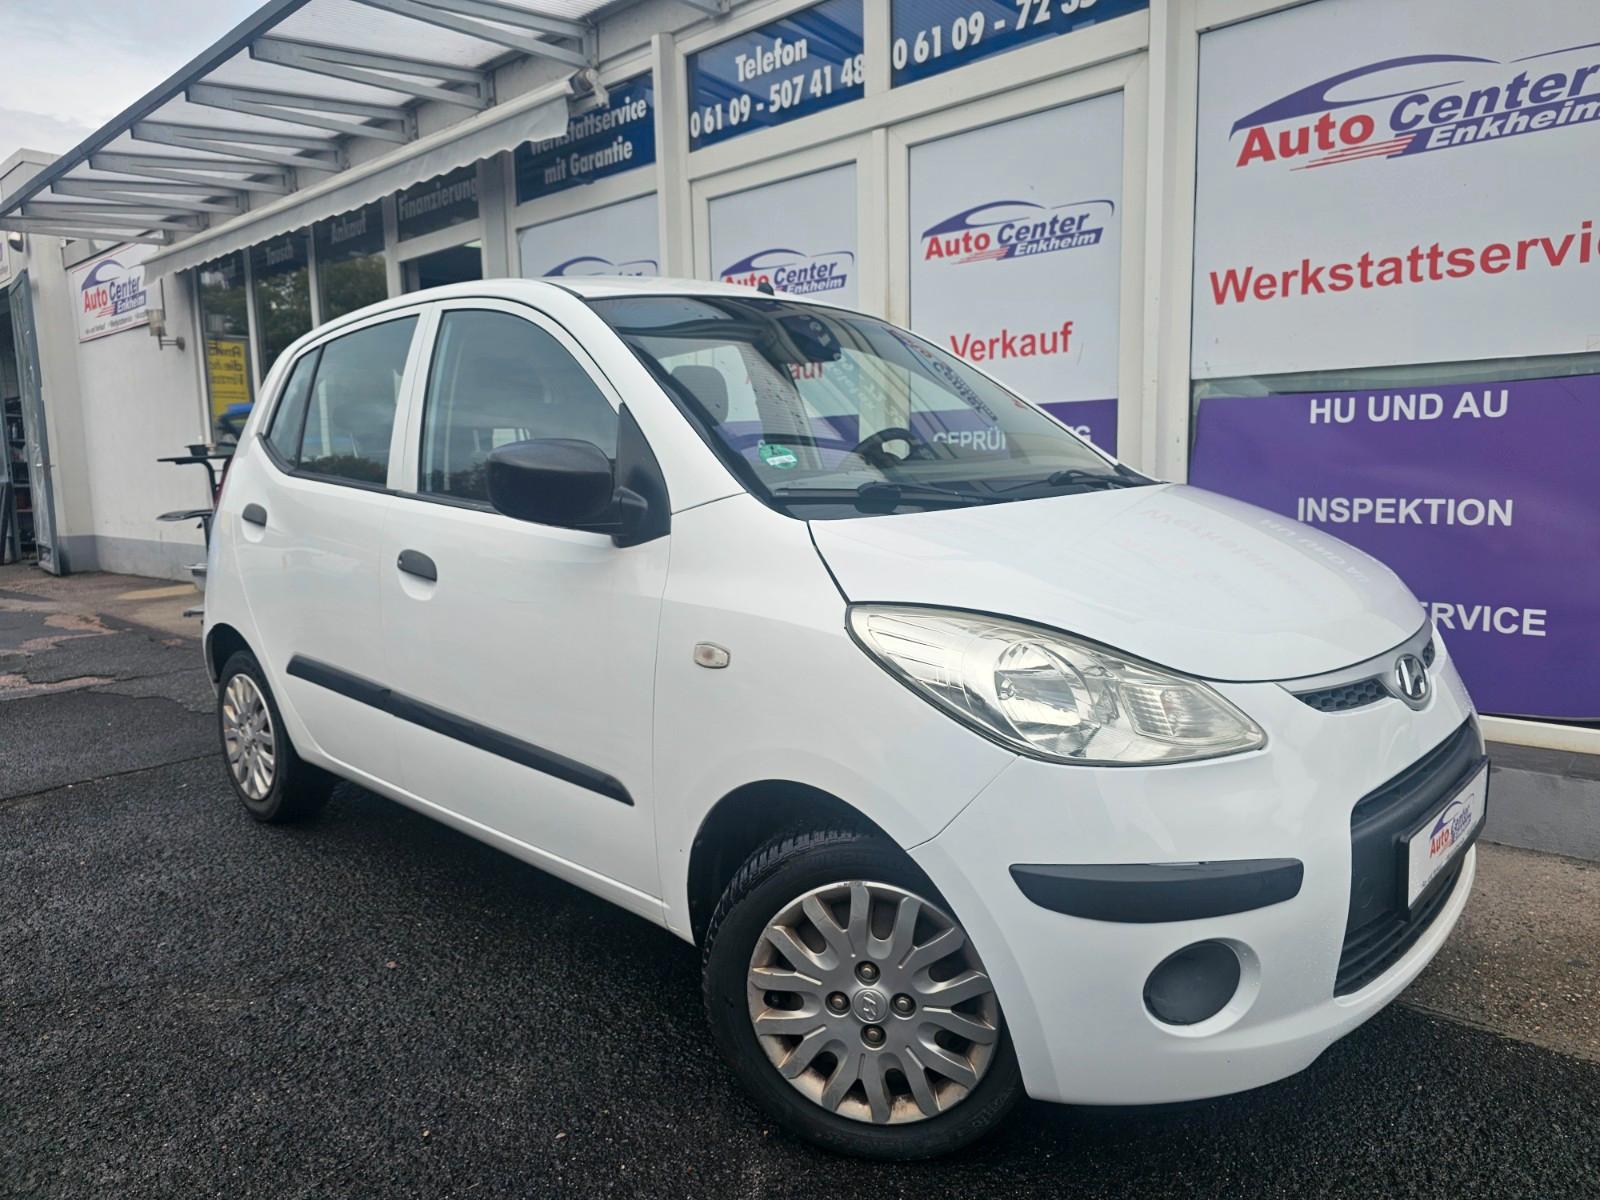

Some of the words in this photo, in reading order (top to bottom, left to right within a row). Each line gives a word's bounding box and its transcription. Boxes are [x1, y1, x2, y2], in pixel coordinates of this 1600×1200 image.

[735, 37, 807, 82] Telefon
[893, 38, 908, 70] 0
[914, 25, 941, 63] 61
[952, 11, 984, 50] 09
[690, 111, 700, 138] 0
[704, 104, 722, 134] 61
[729, 94, 750, 125] 09
[769, 75, 804, 113] 507
[810, 65, 832, 97] 41
[840, 53, 865, 87] 48
[1236, 112, 1374, 168] Auto
[1389, 64, 1600, 132] Center
[1425, 100, 1600, 150] Enkheim
[544, 157, 567, 185] mit
[570, 135, 633, 176] Garantie
[399, 178, 479, 221] Finanzierung
[925, 230, 990, 261] Auto
[997, 213, 1090, 245] Center
[1014, 231, 1096, 257] Enkheim
[774, 261, 838, 285] Center
[1209, 220, 1600, 305] Werkstattservi
[84, 287, 108, 312] Auto
[109, 276, 141, 301] Center
[786, 279, 842, 294] Enkheim
[950, 321, 1073, 362] Verkauf
[1309, 397, 1356, 424] HU
[1367, 393, 1444, 422] UND
[1453, 390, 1509, 419] AU
[933, 426, 1007, 451] GEPRÜ
[1297, 497, 1514, 526] INSPEKTION
[1420, 601, 1547, 637] RVICE
[1429, 828, 1450, 859] Auto
